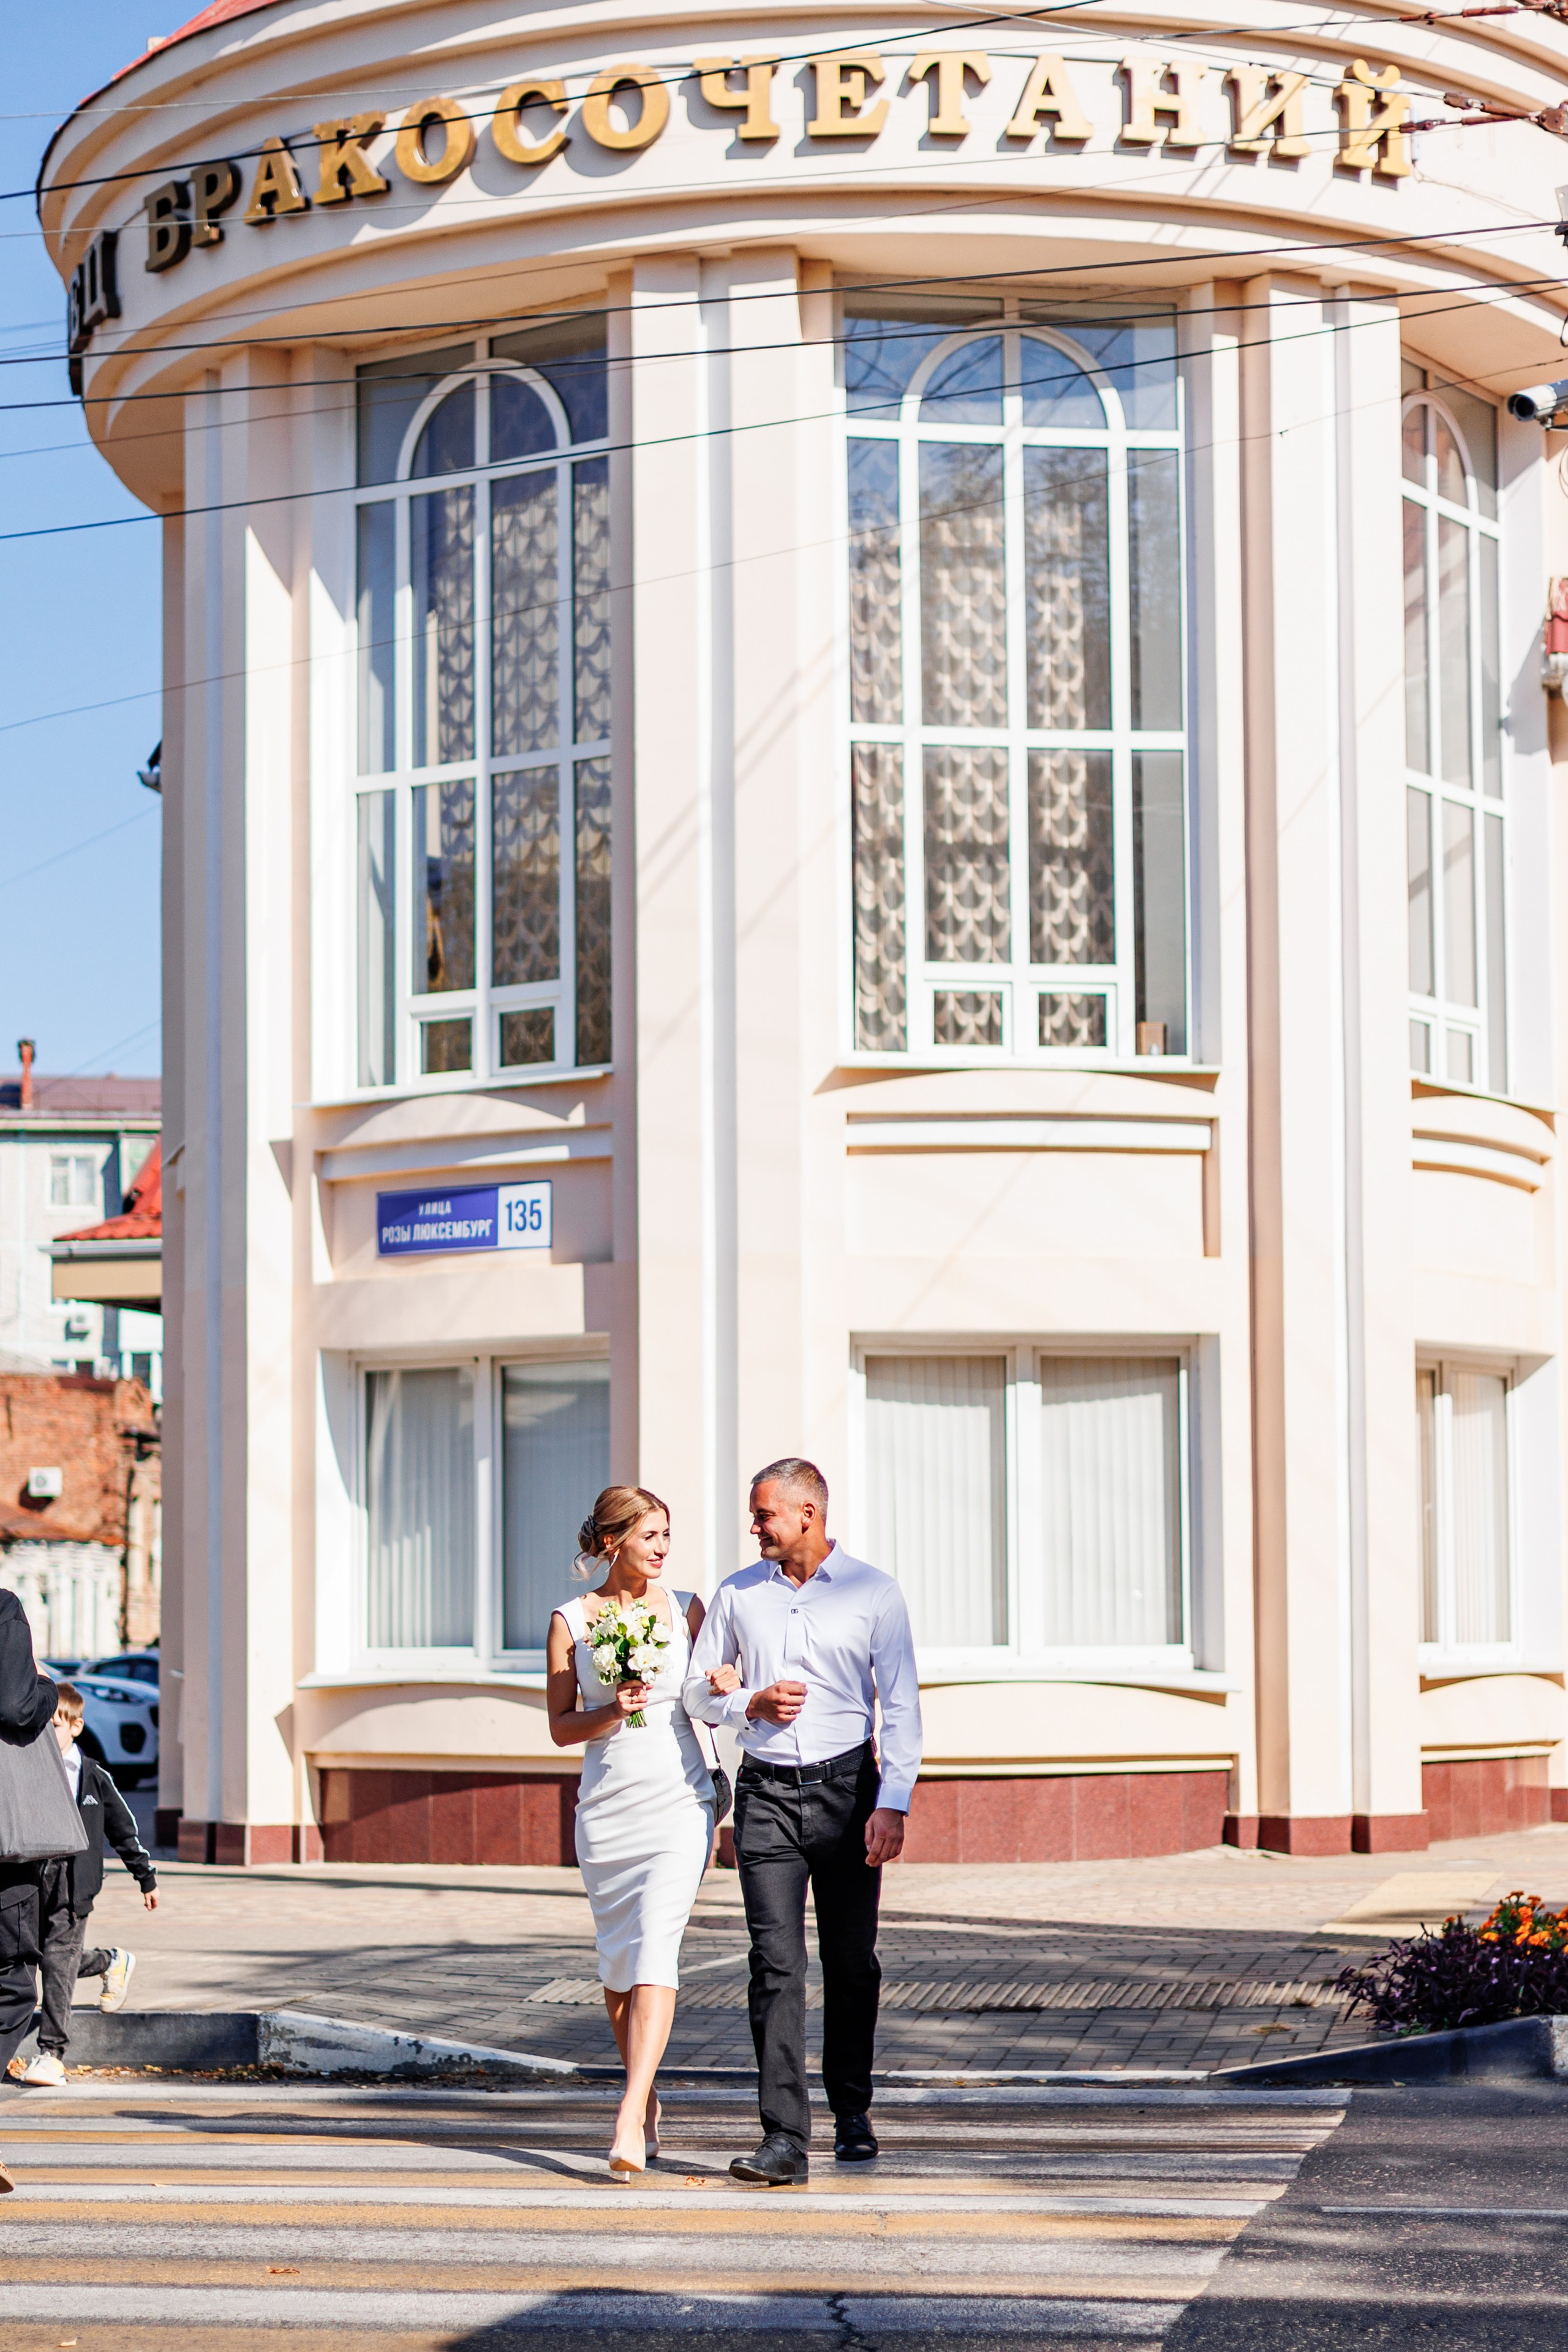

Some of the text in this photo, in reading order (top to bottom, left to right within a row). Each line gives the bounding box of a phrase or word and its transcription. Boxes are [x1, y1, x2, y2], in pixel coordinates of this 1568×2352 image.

[144, 50, 1411, 273] БРАКОСОЧЕТАНИЙ
[418, 1200, 451, 1216] УЛИЦА
[505, 1199, 542, 1231] 135
[382, 1219, 493, 1243] РОЗЫ ЛЮКСЕМБУРГ
